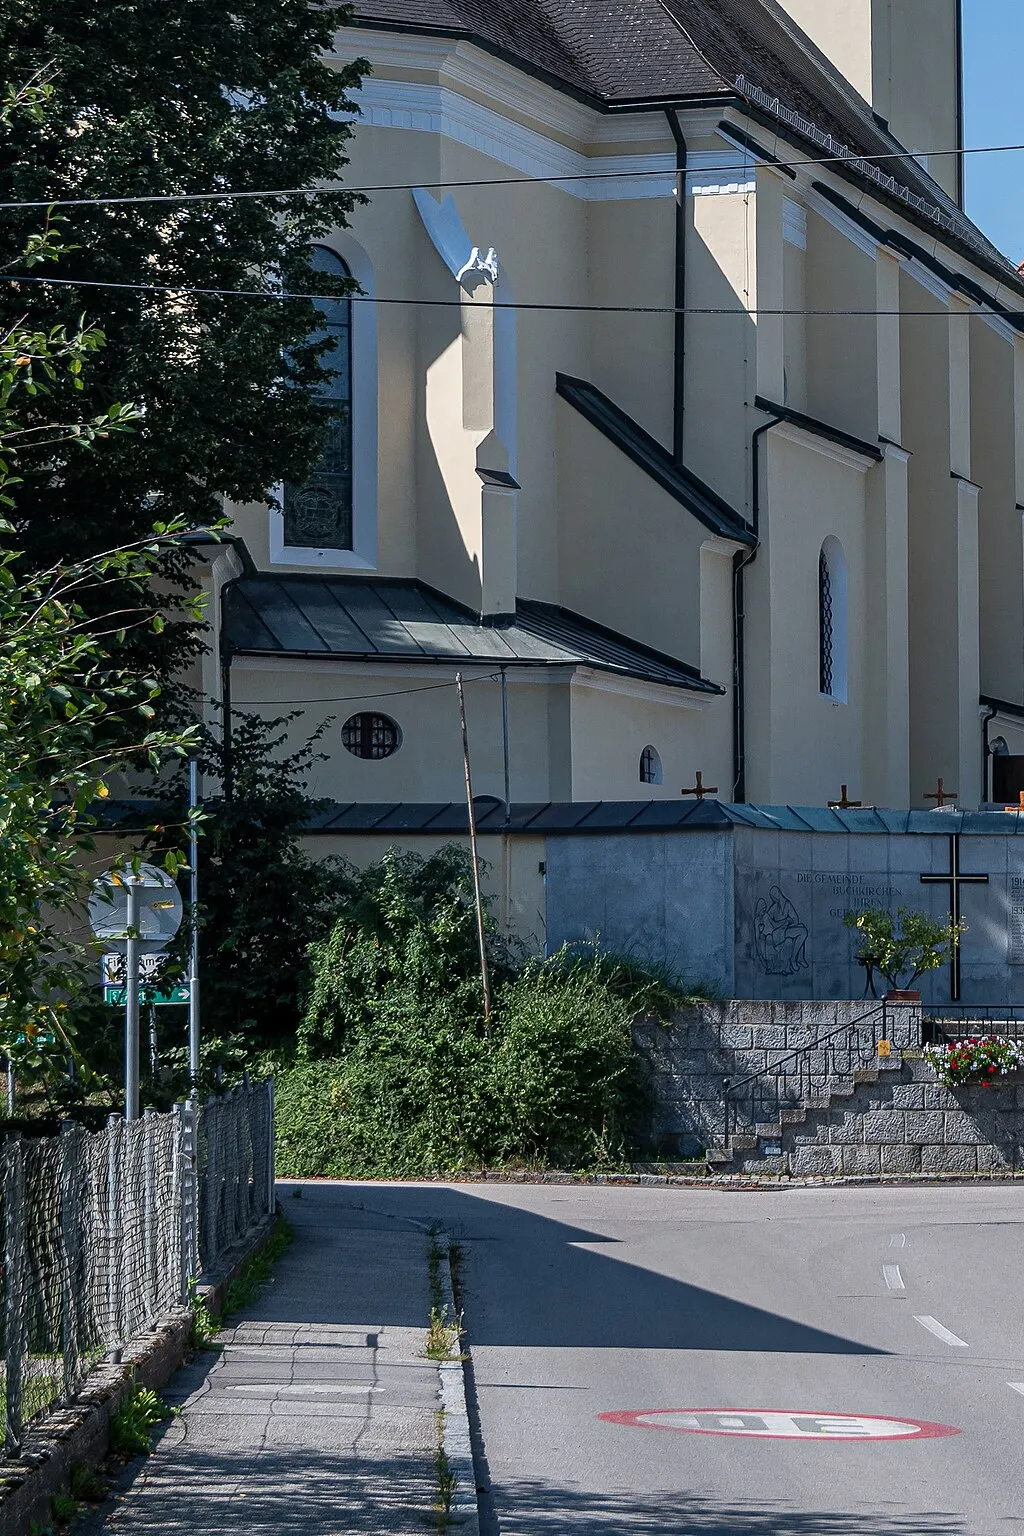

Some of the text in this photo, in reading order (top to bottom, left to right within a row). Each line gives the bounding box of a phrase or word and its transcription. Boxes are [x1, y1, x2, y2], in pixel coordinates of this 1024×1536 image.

[797, 873, 865, 885] DIE GEMEINDE
[832, 886, 903, 896] BUCHKIRCHEN
